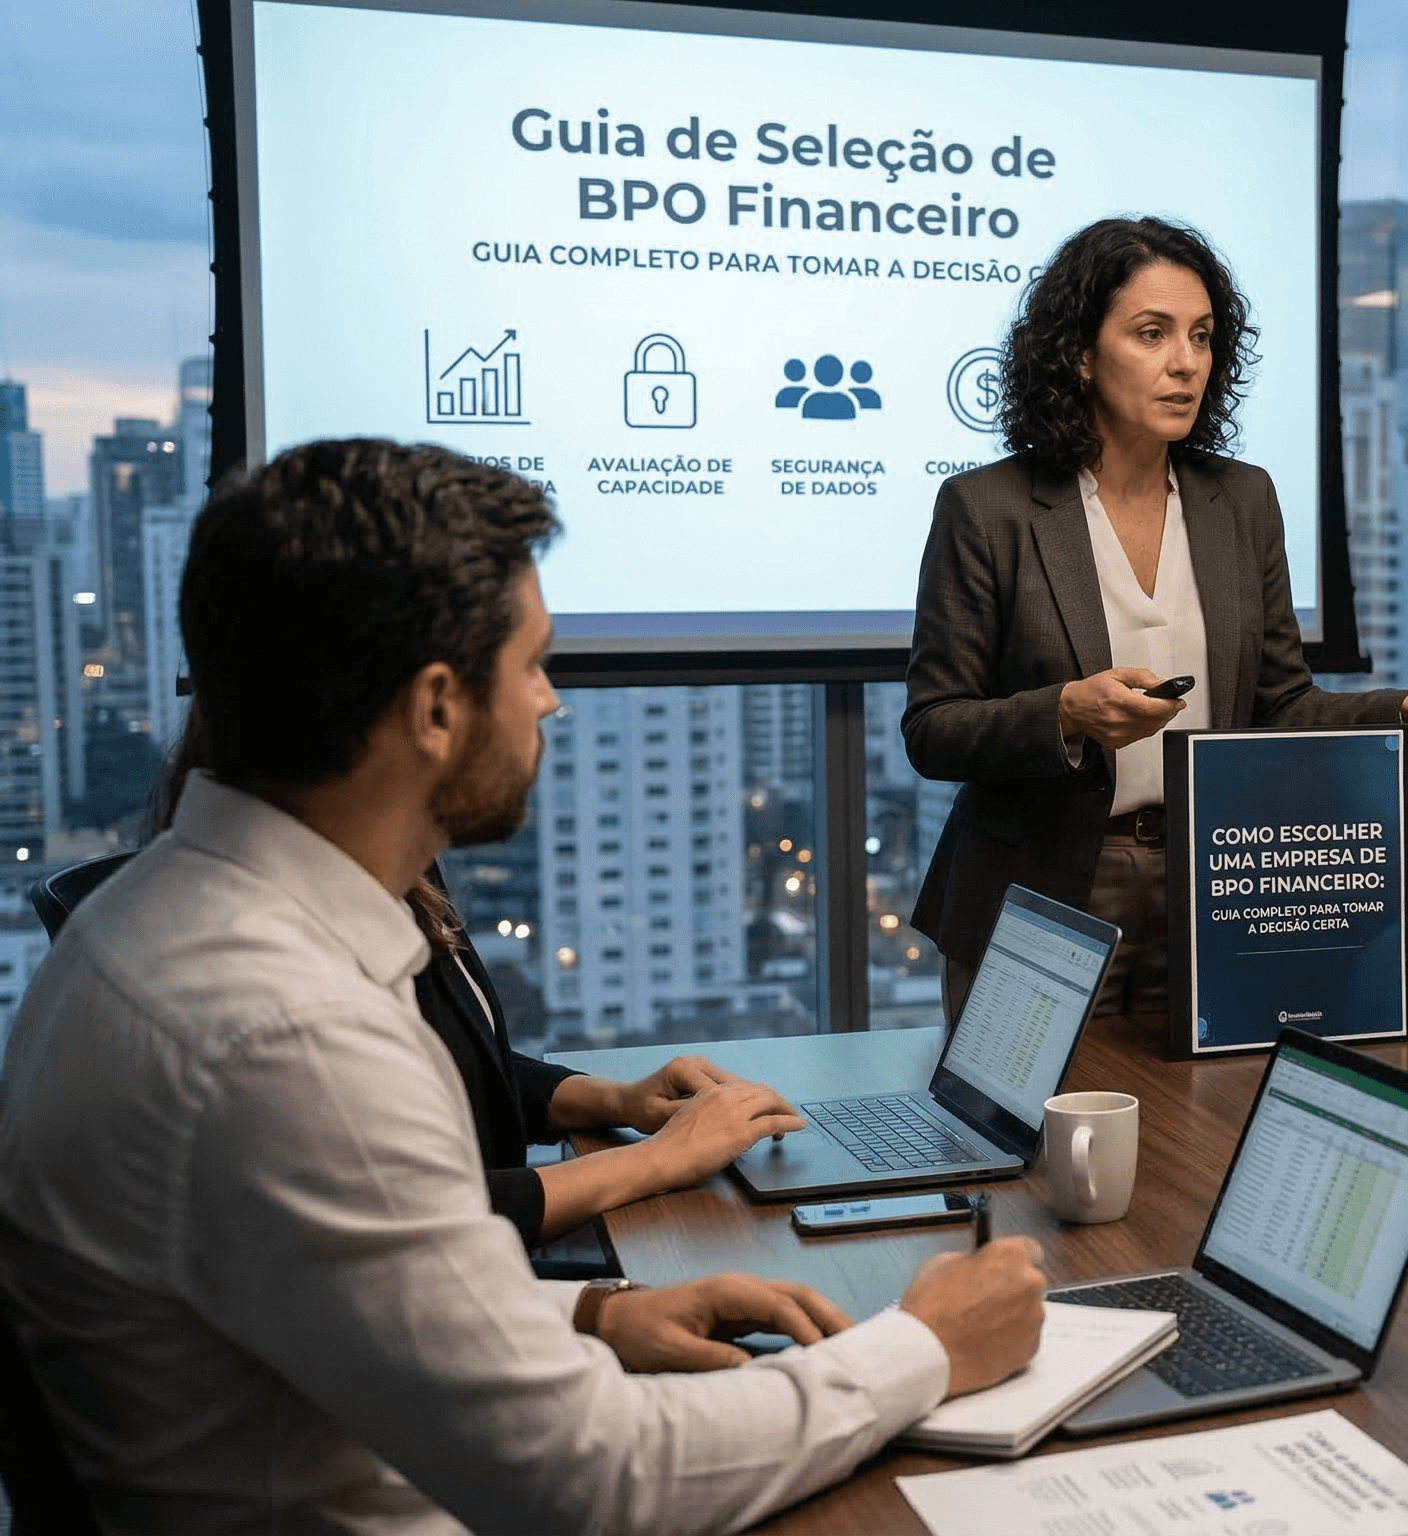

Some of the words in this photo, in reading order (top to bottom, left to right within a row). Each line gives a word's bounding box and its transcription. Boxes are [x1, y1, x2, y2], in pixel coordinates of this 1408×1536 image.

[512, 108, 644, 157] Guia
[667, 116, 737, 162] de
[757, 123, 973, 183] Seleção
[992, 135, 1055, 179] de
[579, 177, 706, 224] BPO
[729, 182, 1019, 239] Financeiro
[473, 242, 542, 263] GUIA
[550, 245, 699, 270] COMPLETO
[709, 252, 779, 272] PARA
[787, 256, 879, 277] TOMAR
[888, 260, 905, 278] A
[914, 259, 1021, 283] DECISÃO
[518, 456, 544, 471] DE
[588, 455, 702, 476] AVALIAÇÃO
[711, 459, 733, 473] DE
[772, 460, 885, 478] SEGURANÇA
[598, 480, 724, 494] CAPACIDADE
[782, 482, 805, 495] DE
[812, 482, 877, 495] DADOS
[1213, 827, 1274, 845] COMO
[1281, 823, 1382, 842] ESCOLHER
[1210, 853, 1255, 870] UMA
[1261, 849, 1354, 868] EMPRESA
[1361, 847, 1386, 863] DE
[1212, 878, 1253, 896] BPO
[1260, 873, 1384, 893] FINANCEIRO:
[1212, 909, 1240, 921] GUIA
[1243, 906, 1306, 919] COMPLETO
[1310, 904, 1340, 915] PARA
[1343, 902, 1383, 912] TOMAR
[1248, 924, 1257, 934] A
[1260, 919, 1309, 933] DECISÃO
[1313, 919, 1349, 930] CERTA
